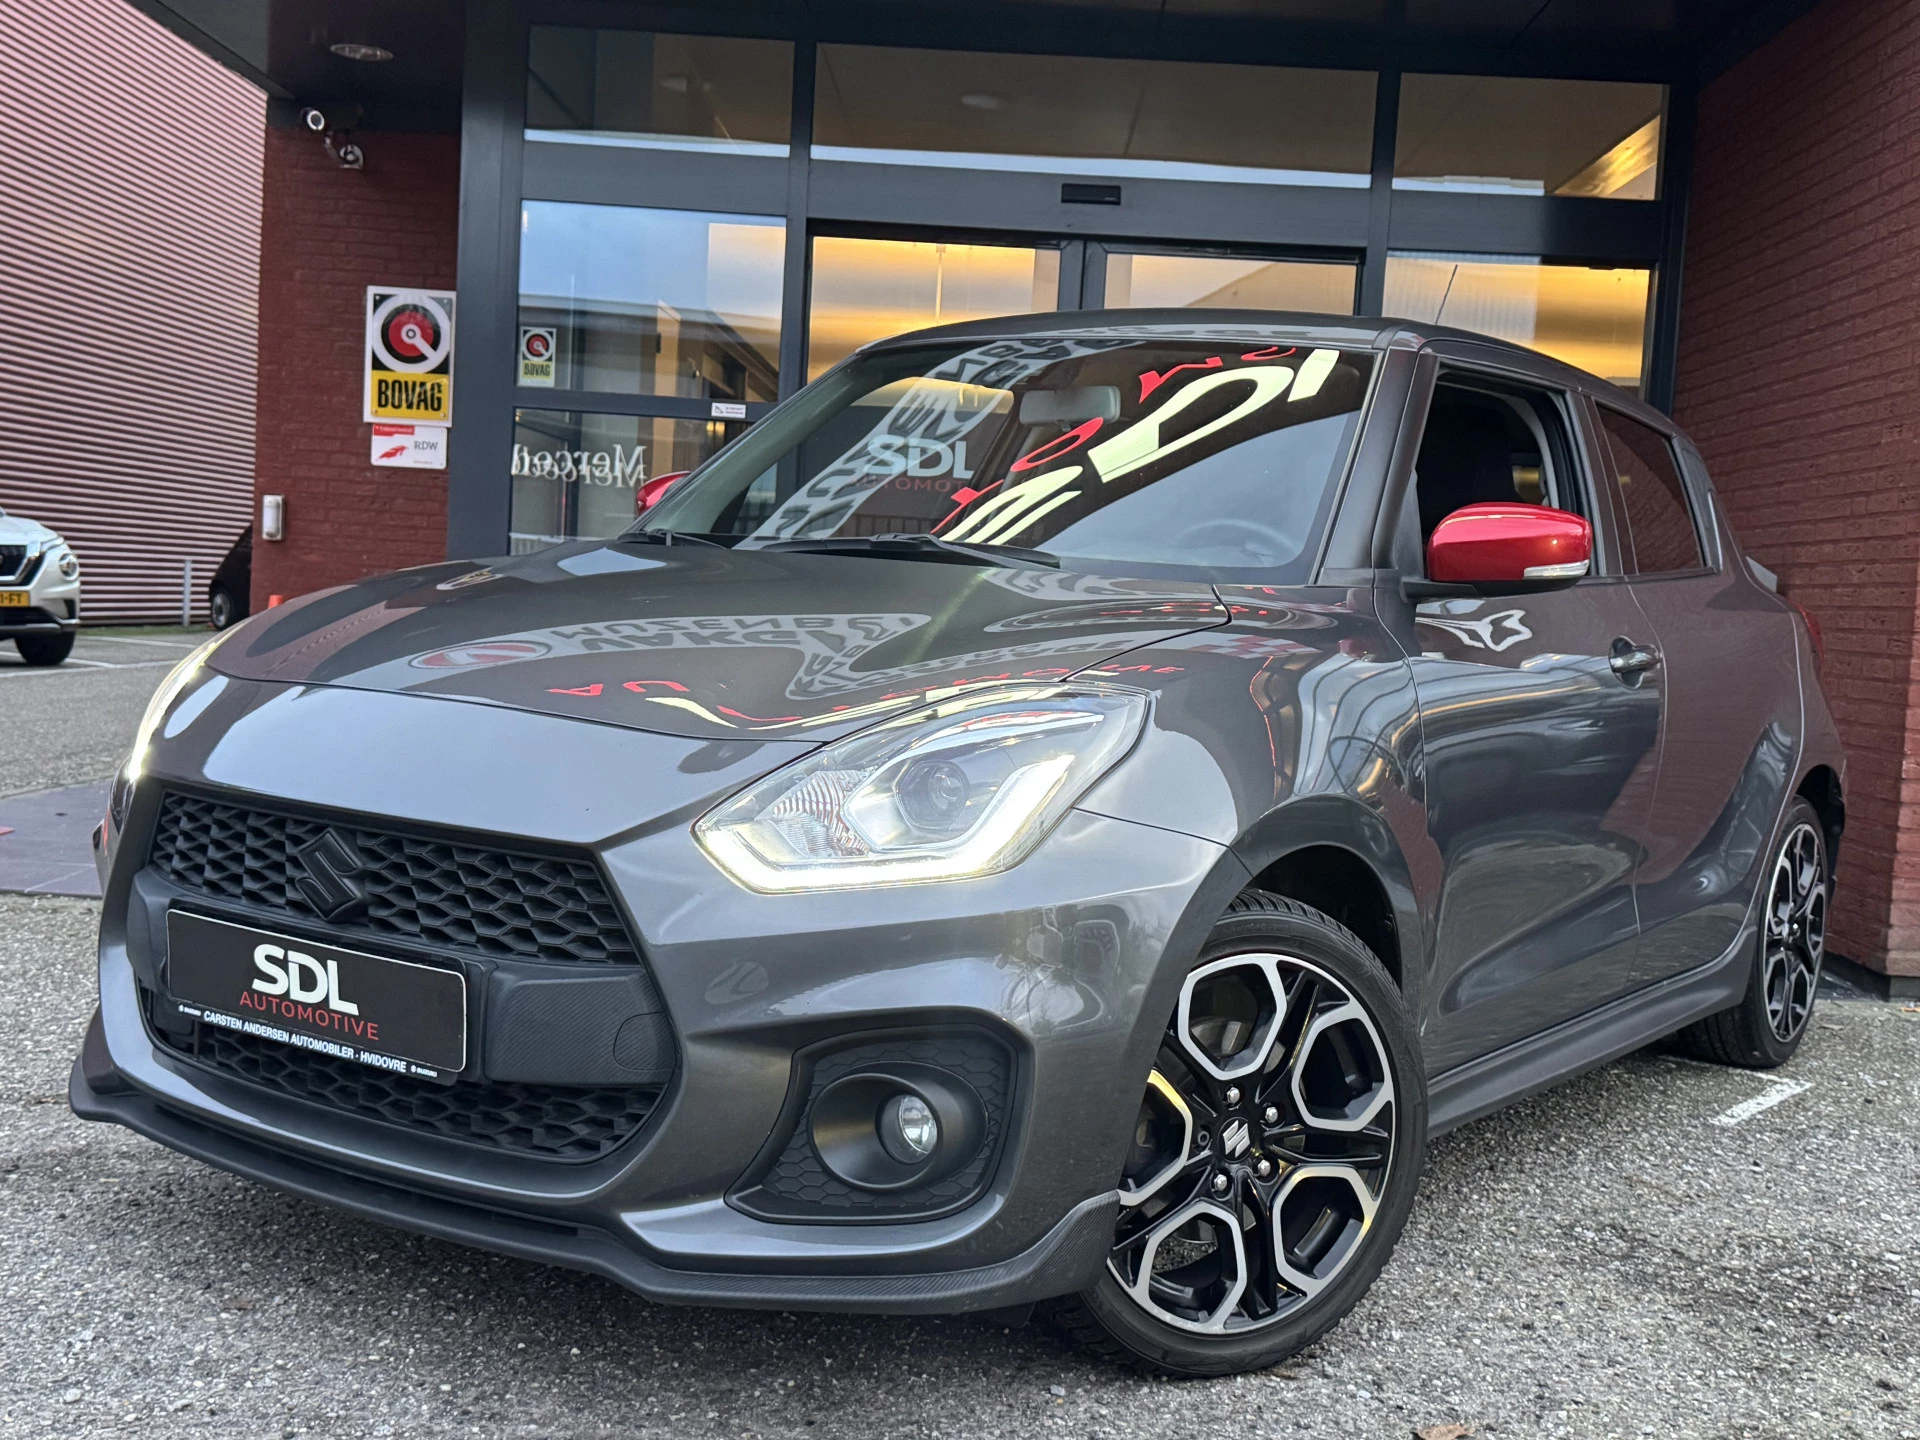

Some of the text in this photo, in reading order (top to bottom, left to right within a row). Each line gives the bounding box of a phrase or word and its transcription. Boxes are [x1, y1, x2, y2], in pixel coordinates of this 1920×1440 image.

[523, 362, 551, 377] BOVAG
[377, 378, 443, 412] BOVAG
[413, 440, 439, 451] RDW
[862, 433, 976, 480] SDL
[251, 943, 360, 1016] SDL
[239, 991, 380, 1041] AUTOMOTIVE
[203, 1010, 243, 1031] CARSTEN
[242, 1021, 290, 1043] ANDERSEN
[289, 1033, 355, 1060] AUTOMOBILER
[359, 1050, 407, 1073] HVIDOVRE
